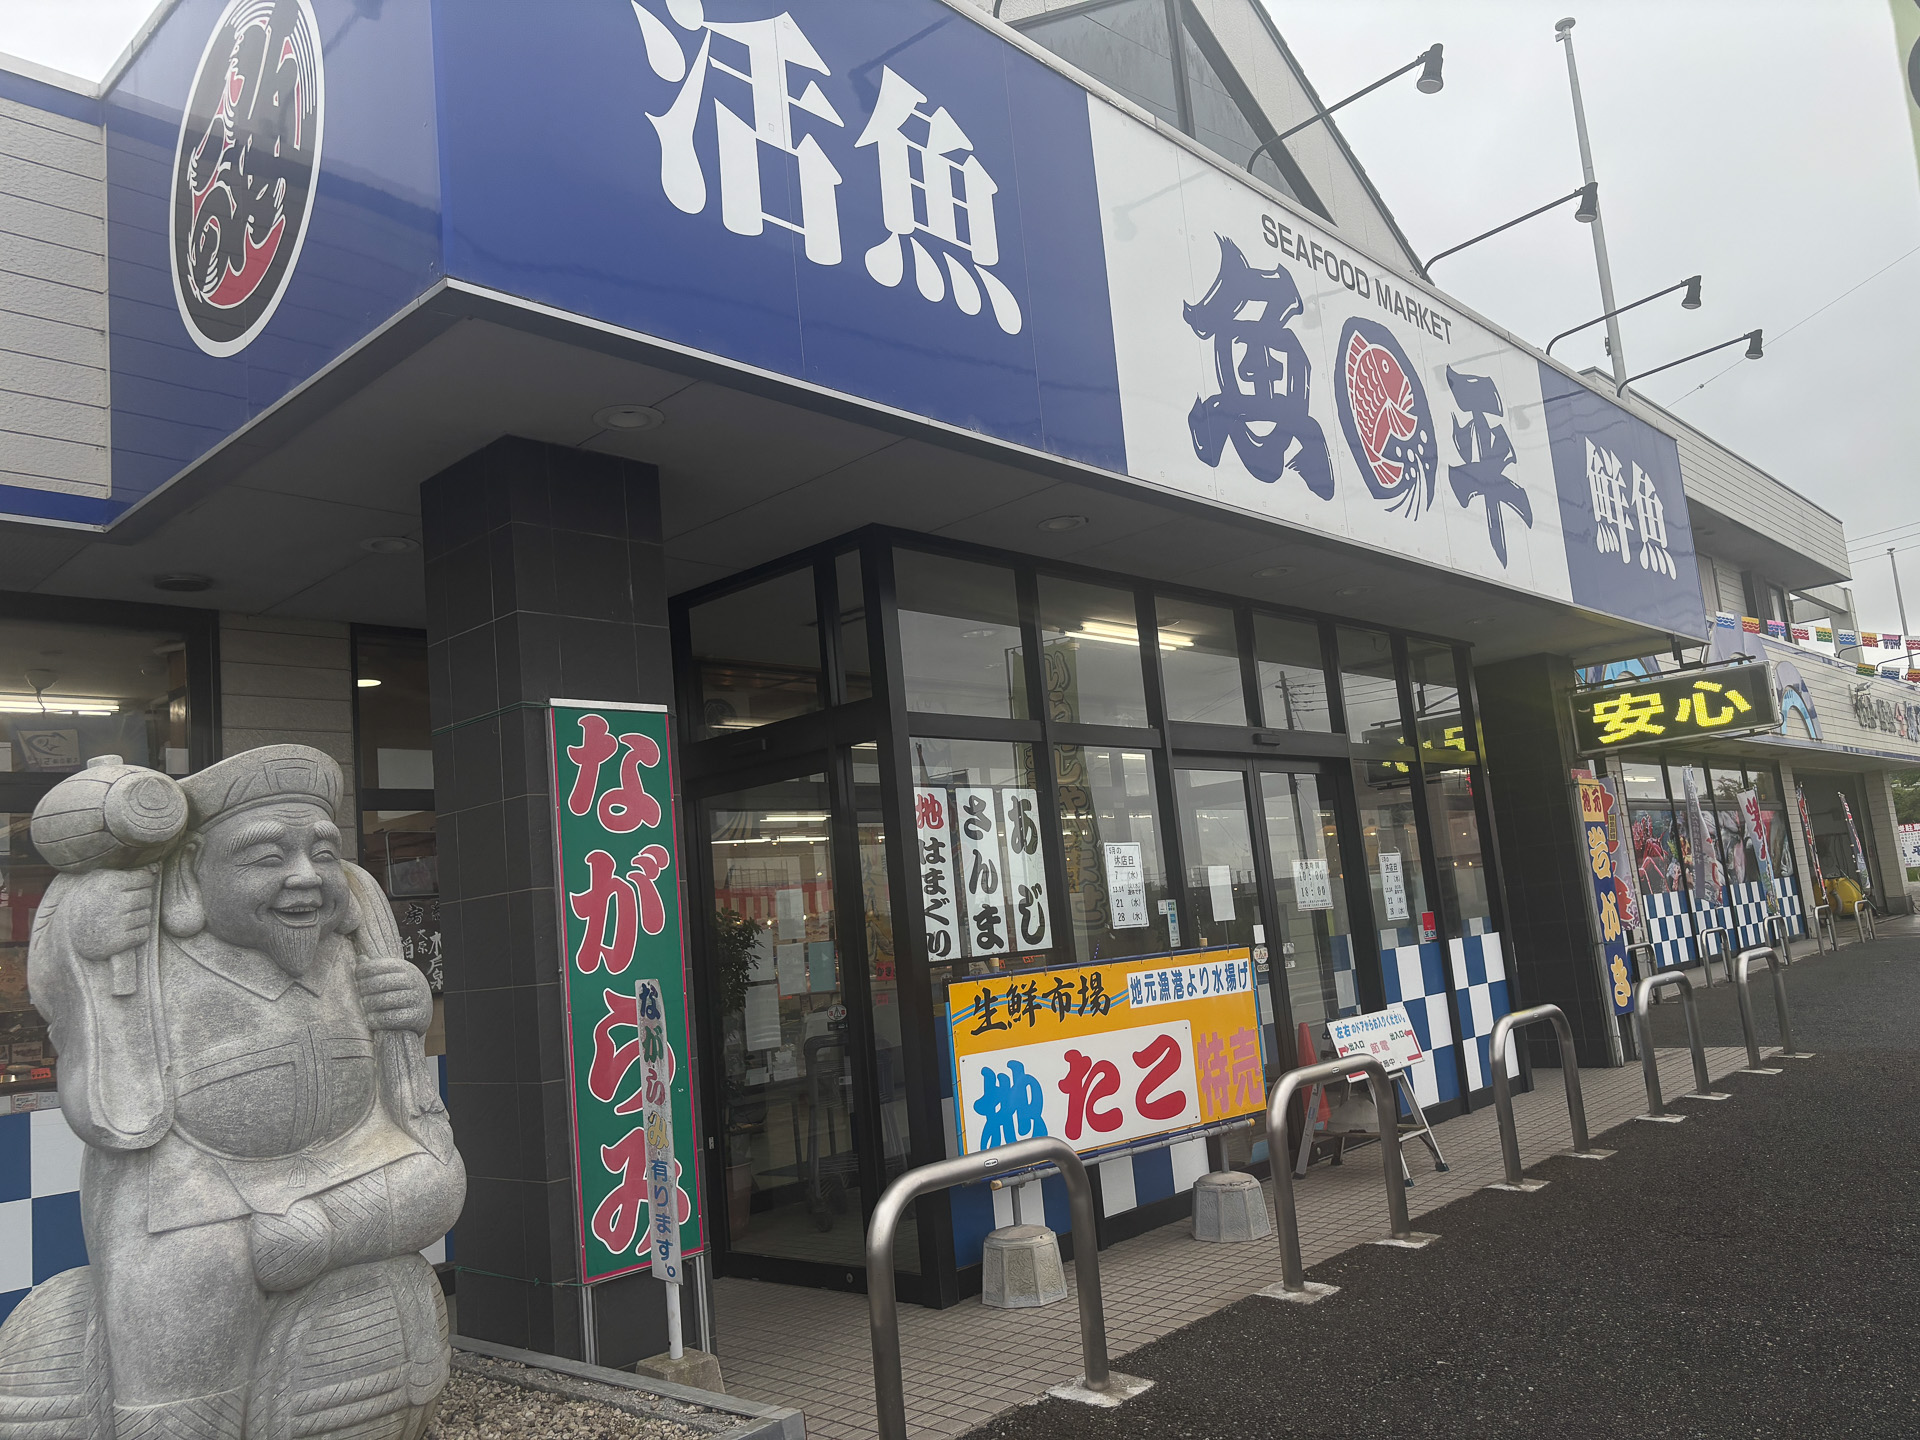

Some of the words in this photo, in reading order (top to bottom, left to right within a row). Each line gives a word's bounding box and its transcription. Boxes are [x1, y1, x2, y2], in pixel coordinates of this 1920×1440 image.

[630, 0, 1023, 336] 活魚
[1260, 213, 1371, 300] SEAFOOD
[1375, 280, 1452, 346] MARKET
[1584, 435, 1677, 580] 鮮魚
[1592, 680, 1752, 744] 安心
[1581, 787, 1602, 814] 地元
[914, 793, 951, 958] 地はまぐり
[962, 794, 1005, 950] さんま
[1007, 794, 1046, 946] あじ
[1113, 855, 1134, 866] 休店日
[1115, 899, 1124, 908] 21
[1117, 912, 1126, 922] 28
[566, 713, 692, 1255] ながらみ
[970, 971, 1111, 1036] 生鮮市場
[1130, 961, 1249, 1006] 地元漁港より水揚げ
[1348, 1040, 1365, 1051] 出入口
[1369, 1040, 1390, 1055] 節電
[1389, 1029, 1405, 1041] 出入口
[973, 1033, 1187, 1152] 地たこ
[1196, 1026, 1264, 1118] 特売
